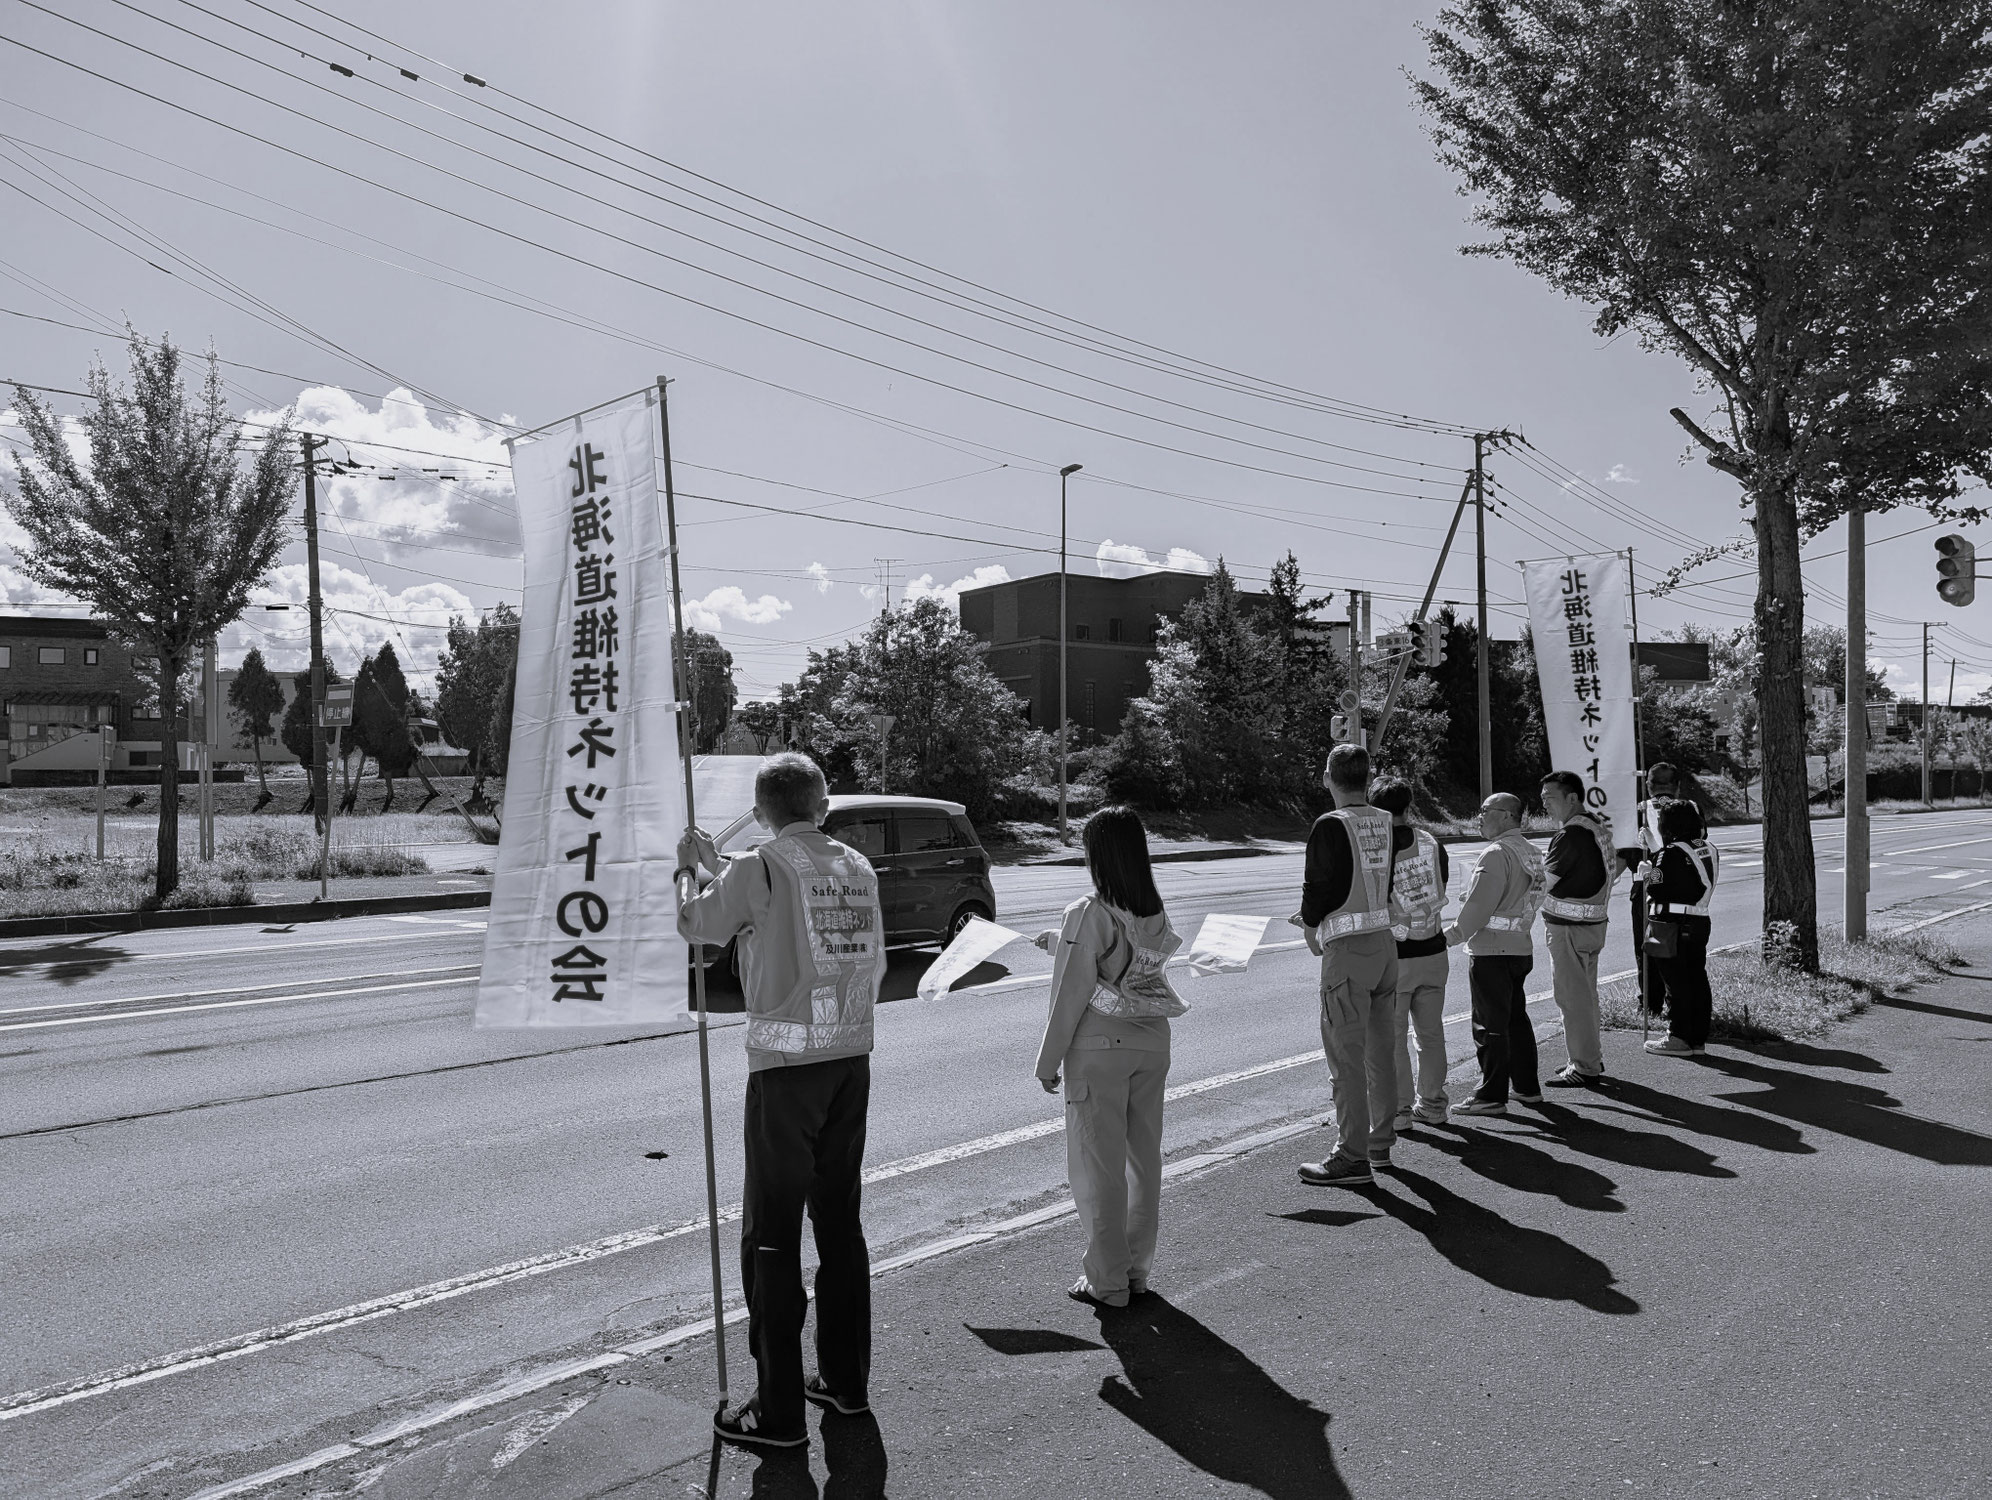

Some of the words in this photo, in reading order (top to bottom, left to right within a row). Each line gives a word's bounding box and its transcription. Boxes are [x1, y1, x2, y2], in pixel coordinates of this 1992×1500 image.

[1408, 859, 1428, 871] Road
[811, 885, 838, 898] Safe
[841, 885, 869, 898] Road
[814, 908, 873, 931] 北海道維持ネット
